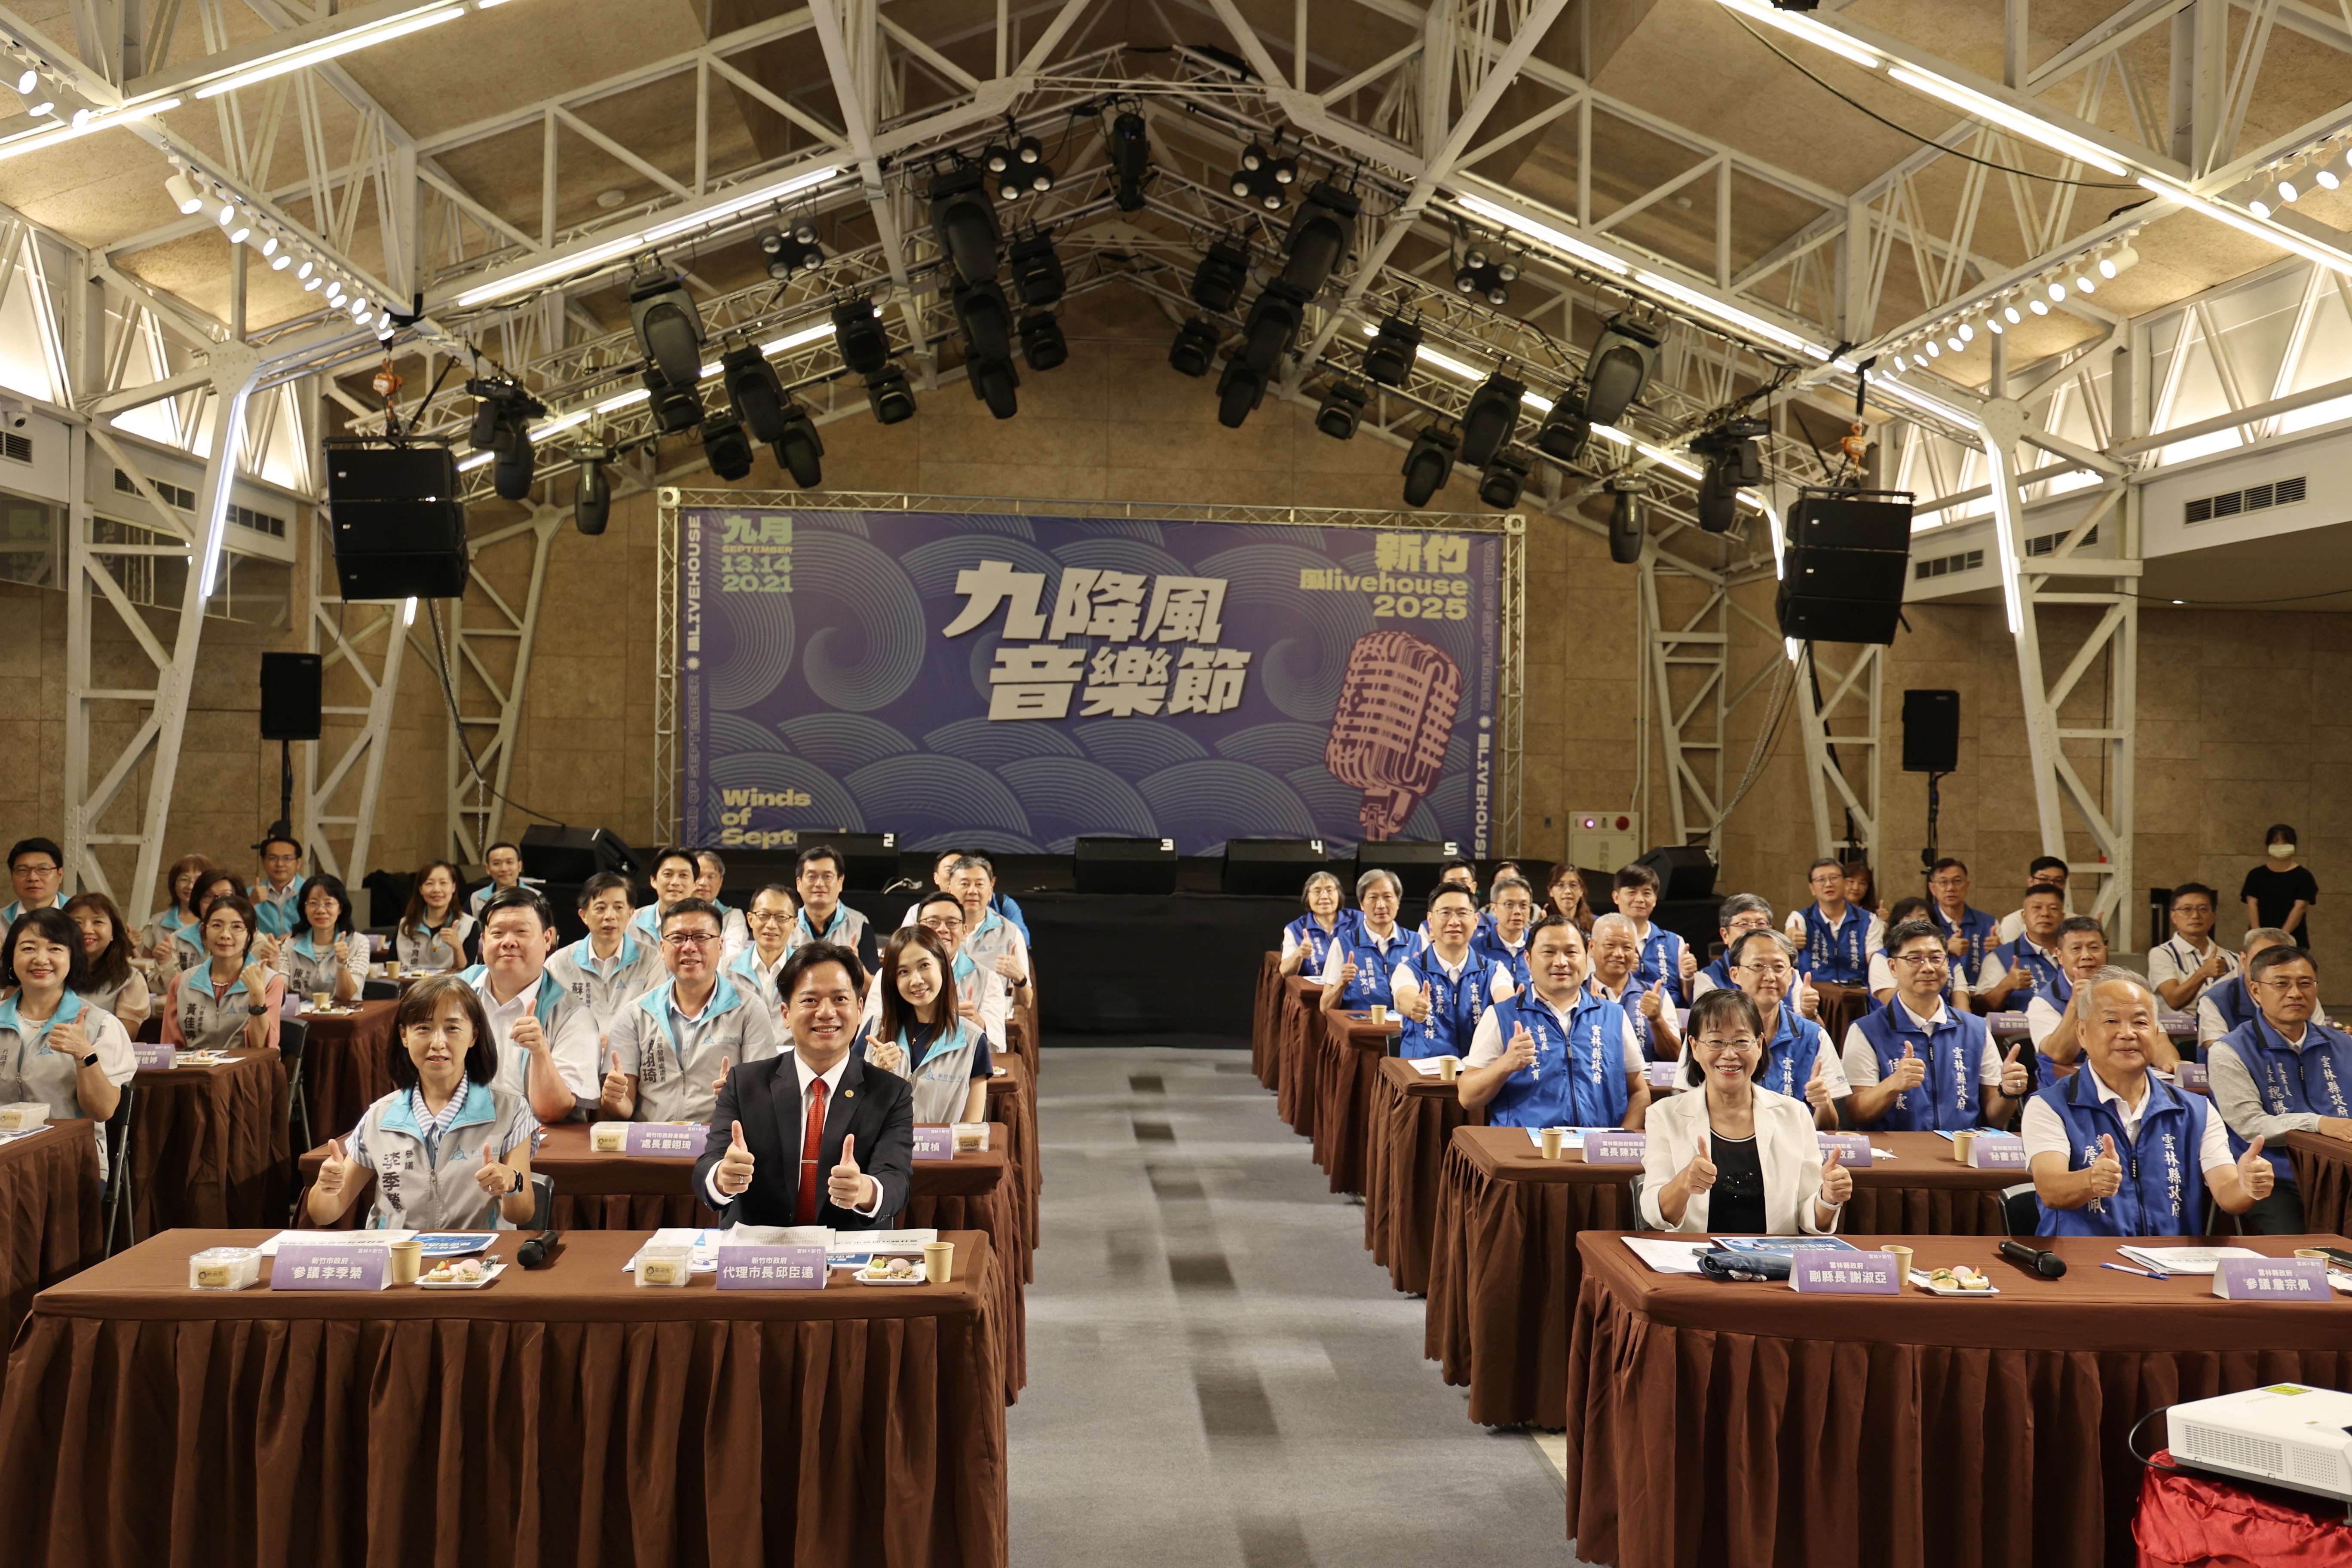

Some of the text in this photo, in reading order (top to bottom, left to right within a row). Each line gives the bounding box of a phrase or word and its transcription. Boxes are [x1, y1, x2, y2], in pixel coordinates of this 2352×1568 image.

[722, 515, 793, 544] 九月
[722, 545, 793, 554] SEPTEMBER
[1375, 533, 1470, 573] 新竹
[721, 554, 793, 573] 13.14
[722, 574, 793, 593] 20.21
[942, 560, 1228, 644] 九降風
[1373, 595, 1468, 620] 2025
[987, 644, 1251, 721] 音樂節
[722, 787, 812, 807] Winds
[720, 807, 752, 826] of
[721, 827, 798, 849] Sept
[883, 833, 894, 847] 2
[1160, 838, 1174, 851] 3
[1311, 840, 1323, 854] 4
[1443, 842, 1457, 855] 5
[1358, 969, 1370, 995] 林文山
[1591, 1025, 1603, 1084] 雲林縣政府
[1782, 1057, 1795, 1096] 雲林縣
[1952, 1047, 1969, 1110] 雲林縣政府
[2321, 1056, 2349, 1117] 雲林縣政府
[404, 1149, 414, 1170] 參議
[382, 1152, 403, 1211] 李季榮
[2082, 1145, 2106, 1214] 詹佩
[2162, 1133, 2182, 1218] 雲林縣政府
[723, 1266, 814, 1279] 代理市長邱臣遠
